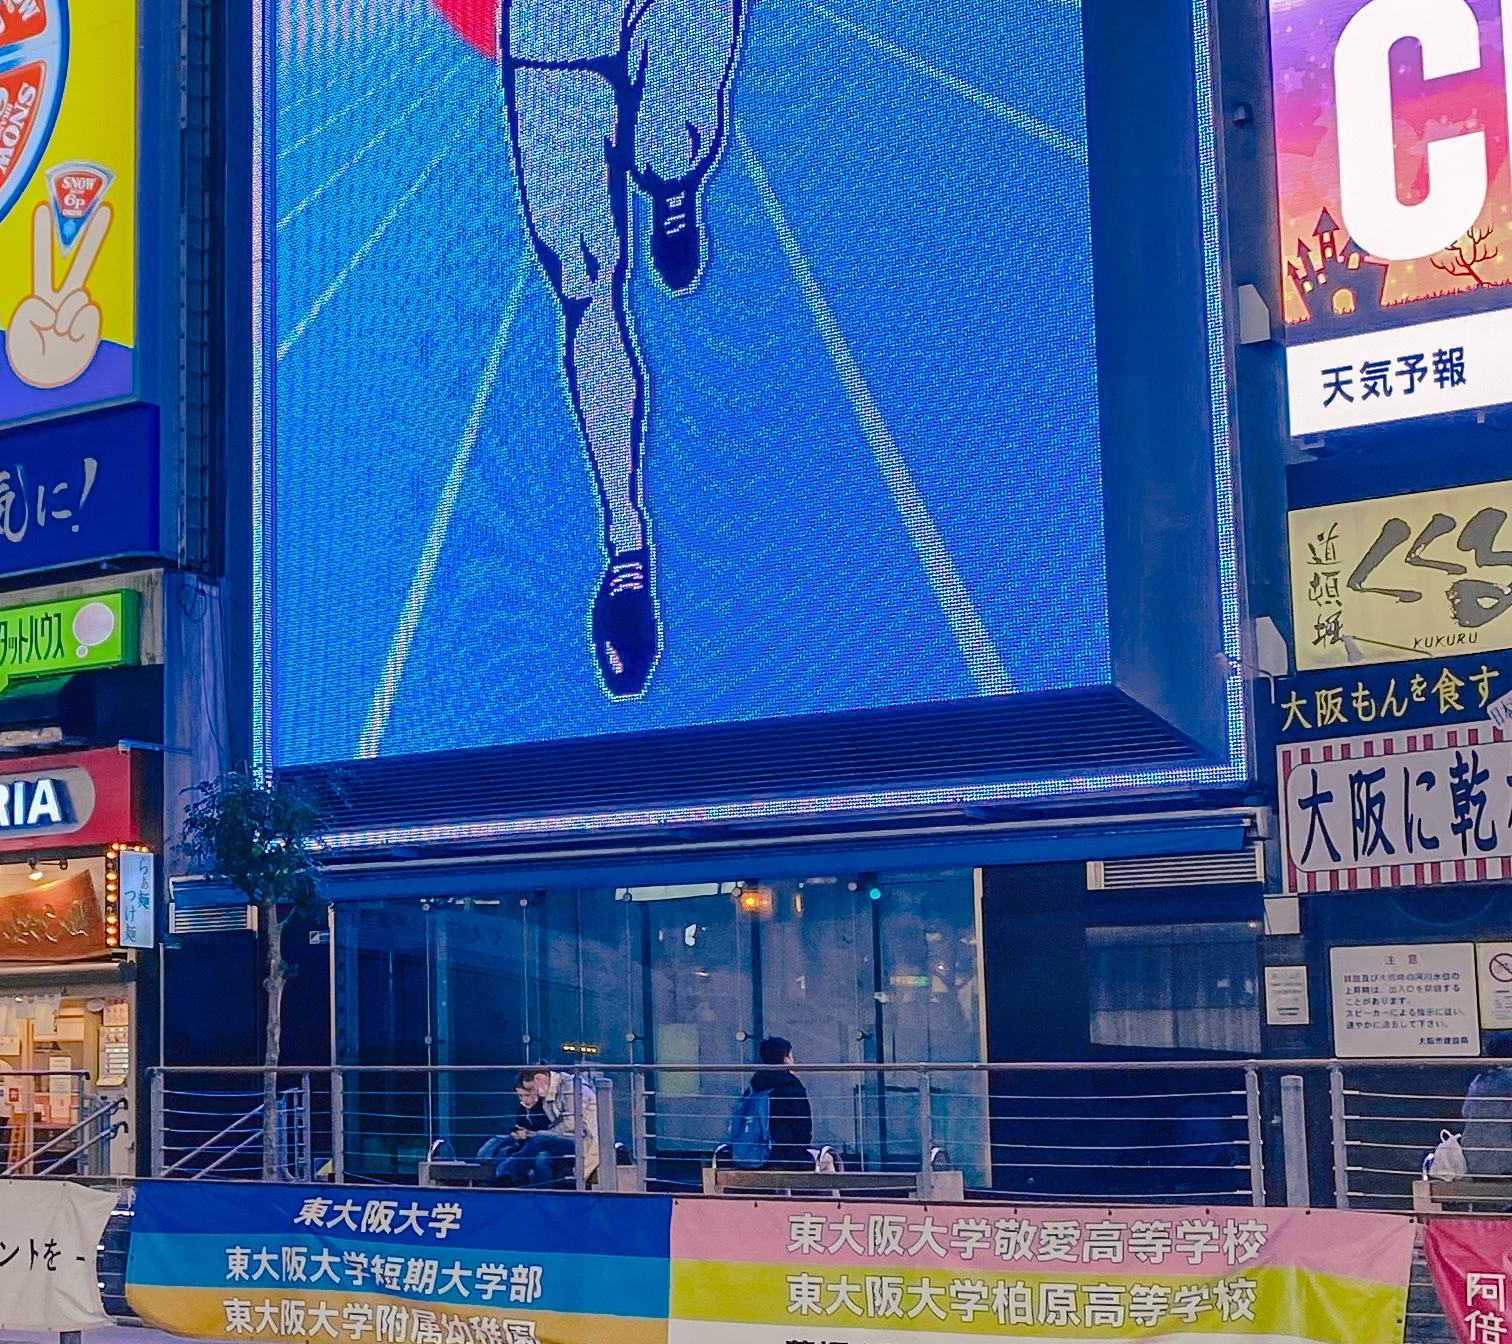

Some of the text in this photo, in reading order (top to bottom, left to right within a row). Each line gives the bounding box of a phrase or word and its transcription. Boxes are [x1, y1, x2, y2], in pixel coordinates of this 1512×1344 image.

[61, 176, 97, 190] SNOW
[1323, 346, 1468, 407] 天気予報
[1306, 522, 1345, 648] 道頓堀
[1413, 632, 1479, 650] KUKURU
[1280, 666, 1500, 733] 大阪もんを食す
[1298, 750, 1512, 866] 大阪に乾
[293, 1196, 463, 1239] 東大阪大学
[786, 1212, 1269, 1266] 東大阪大学敬愛高等学校
[225, 1246, 544, 1304] 東大阪大学短期大学部
[785, 1273, 1258, 1329] 東大阪大学柏原高等学校
